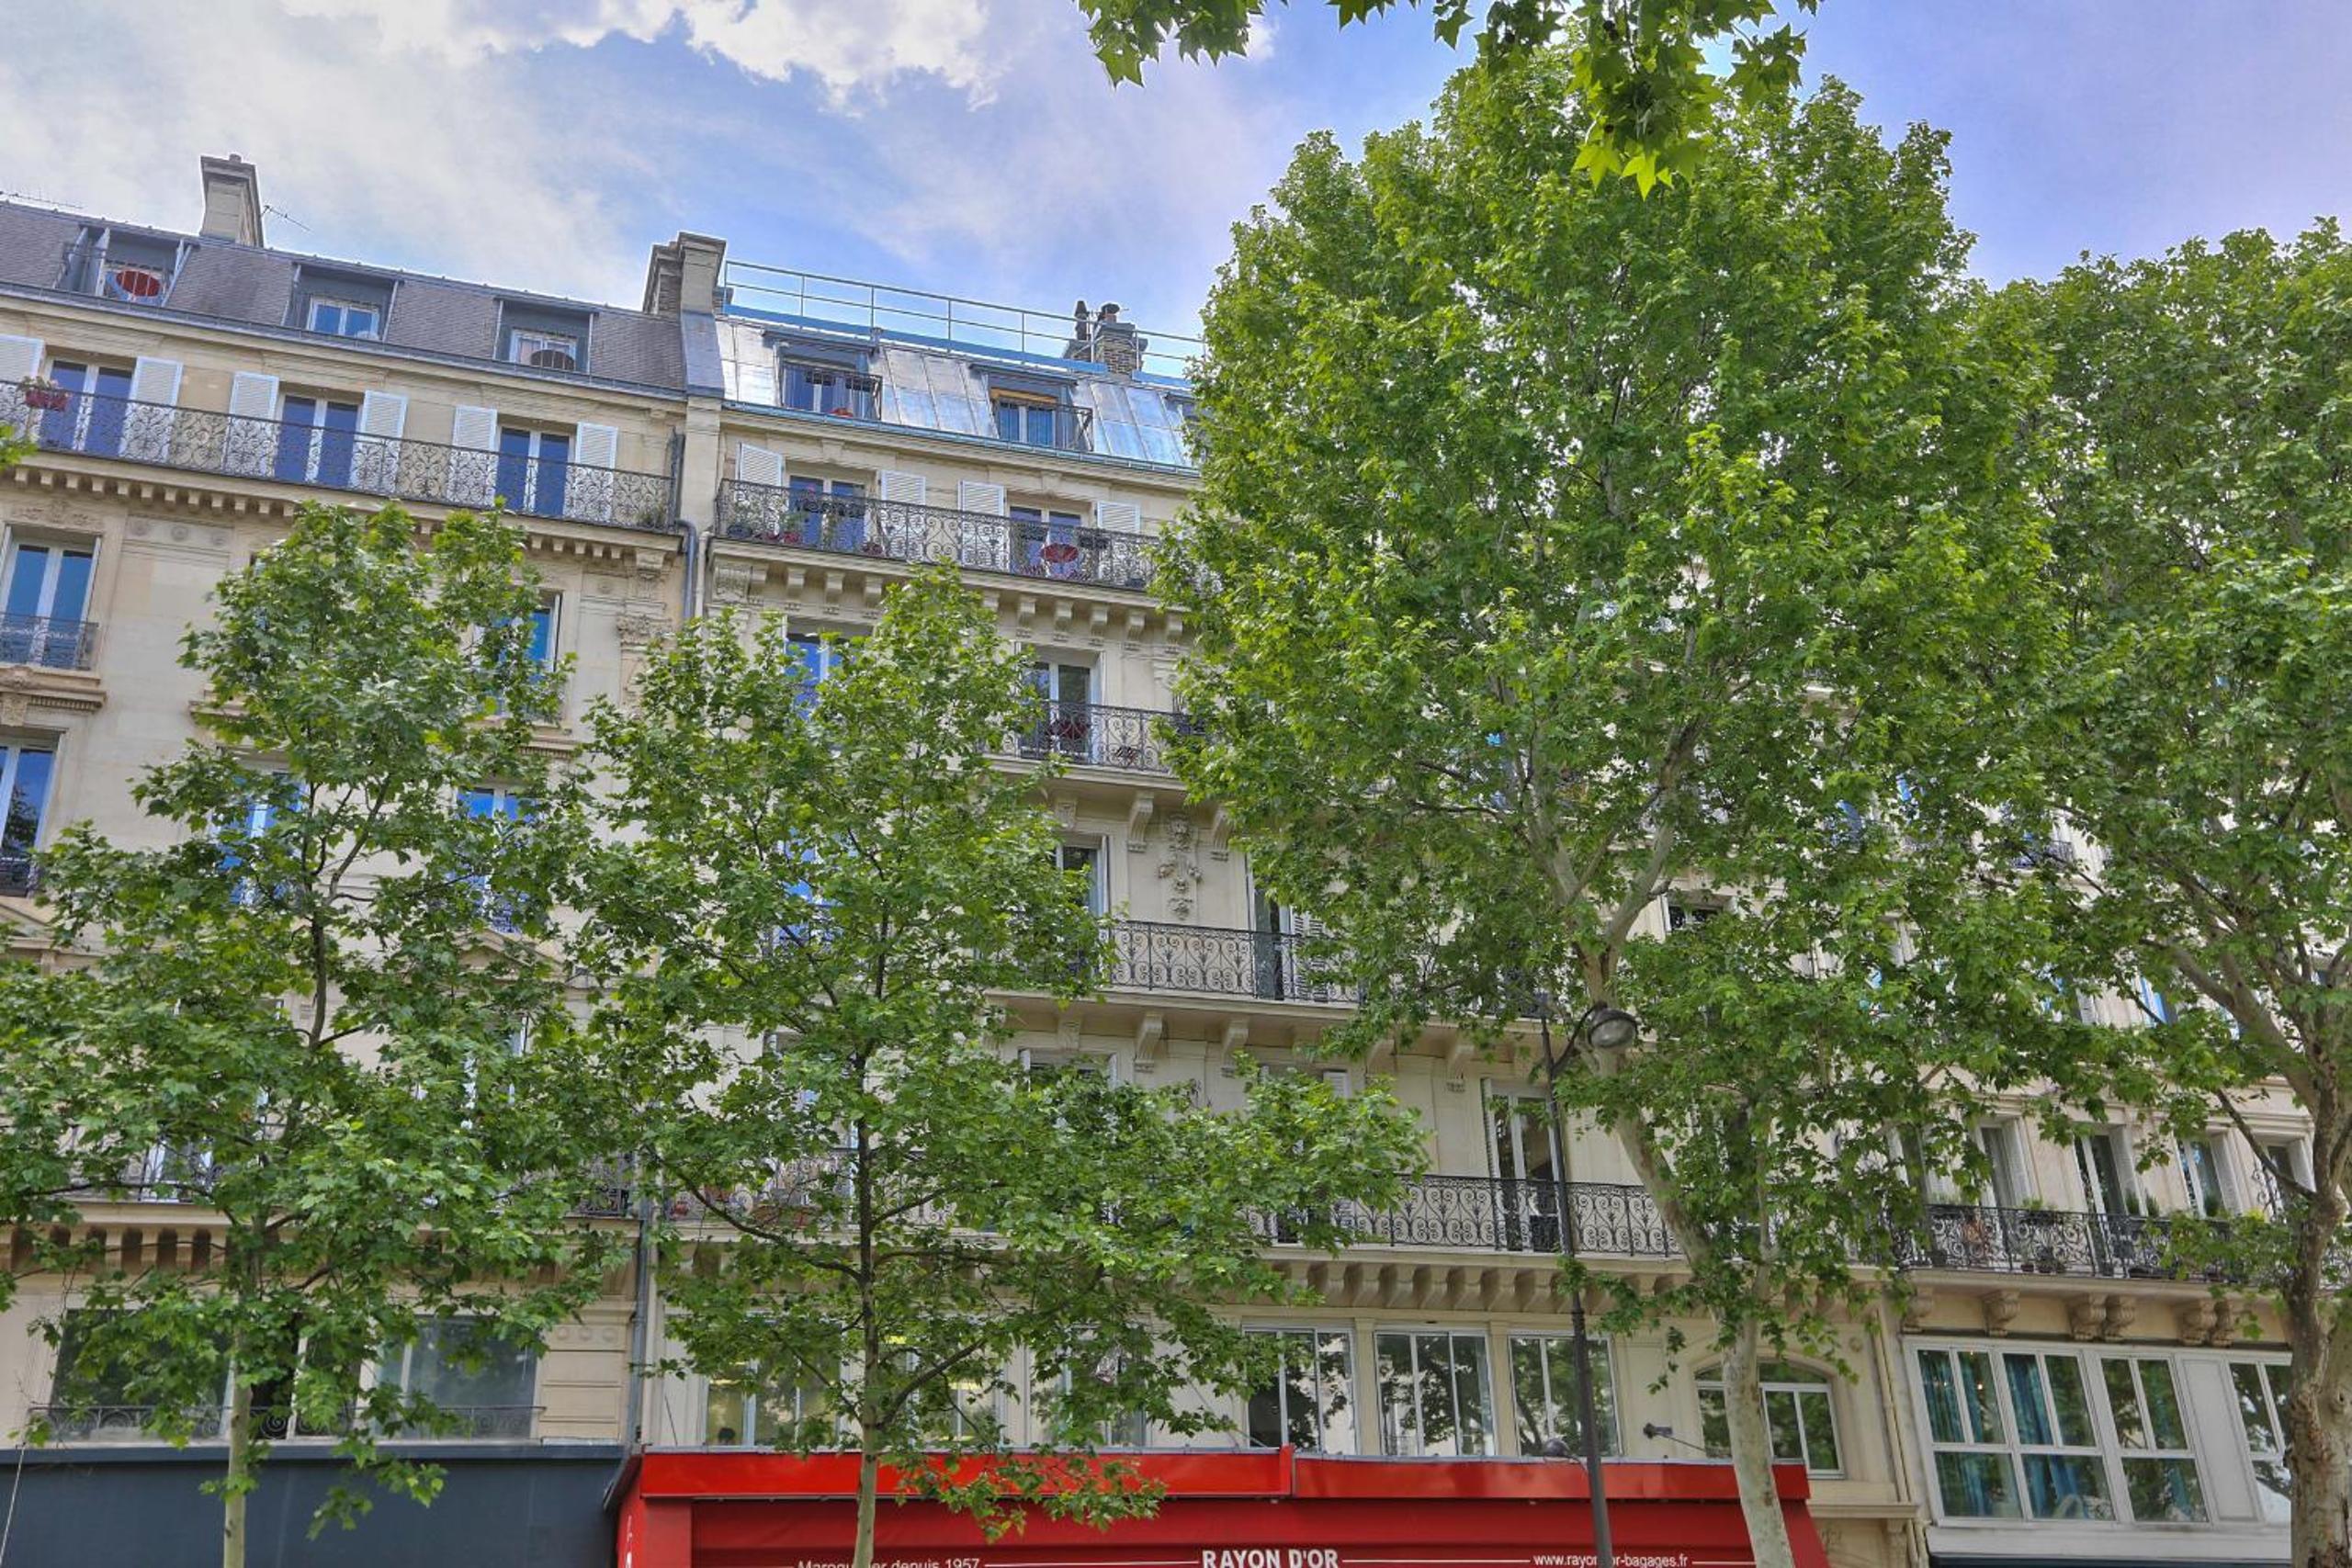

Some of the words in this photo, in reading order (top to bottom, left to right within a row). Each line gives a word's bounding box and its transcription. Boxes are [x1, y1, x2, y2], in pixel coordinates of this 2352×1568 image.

[797, 1560, 887, 1568] Maroer
[945, 1558, 980, 1568] 1957
[1202, 1550, 1281, 1568] RAYON
[1288, 1549, 1340, 1568] D'OR
[1532, 1552, 1688, 1568] www.rayor-bagages.fr
